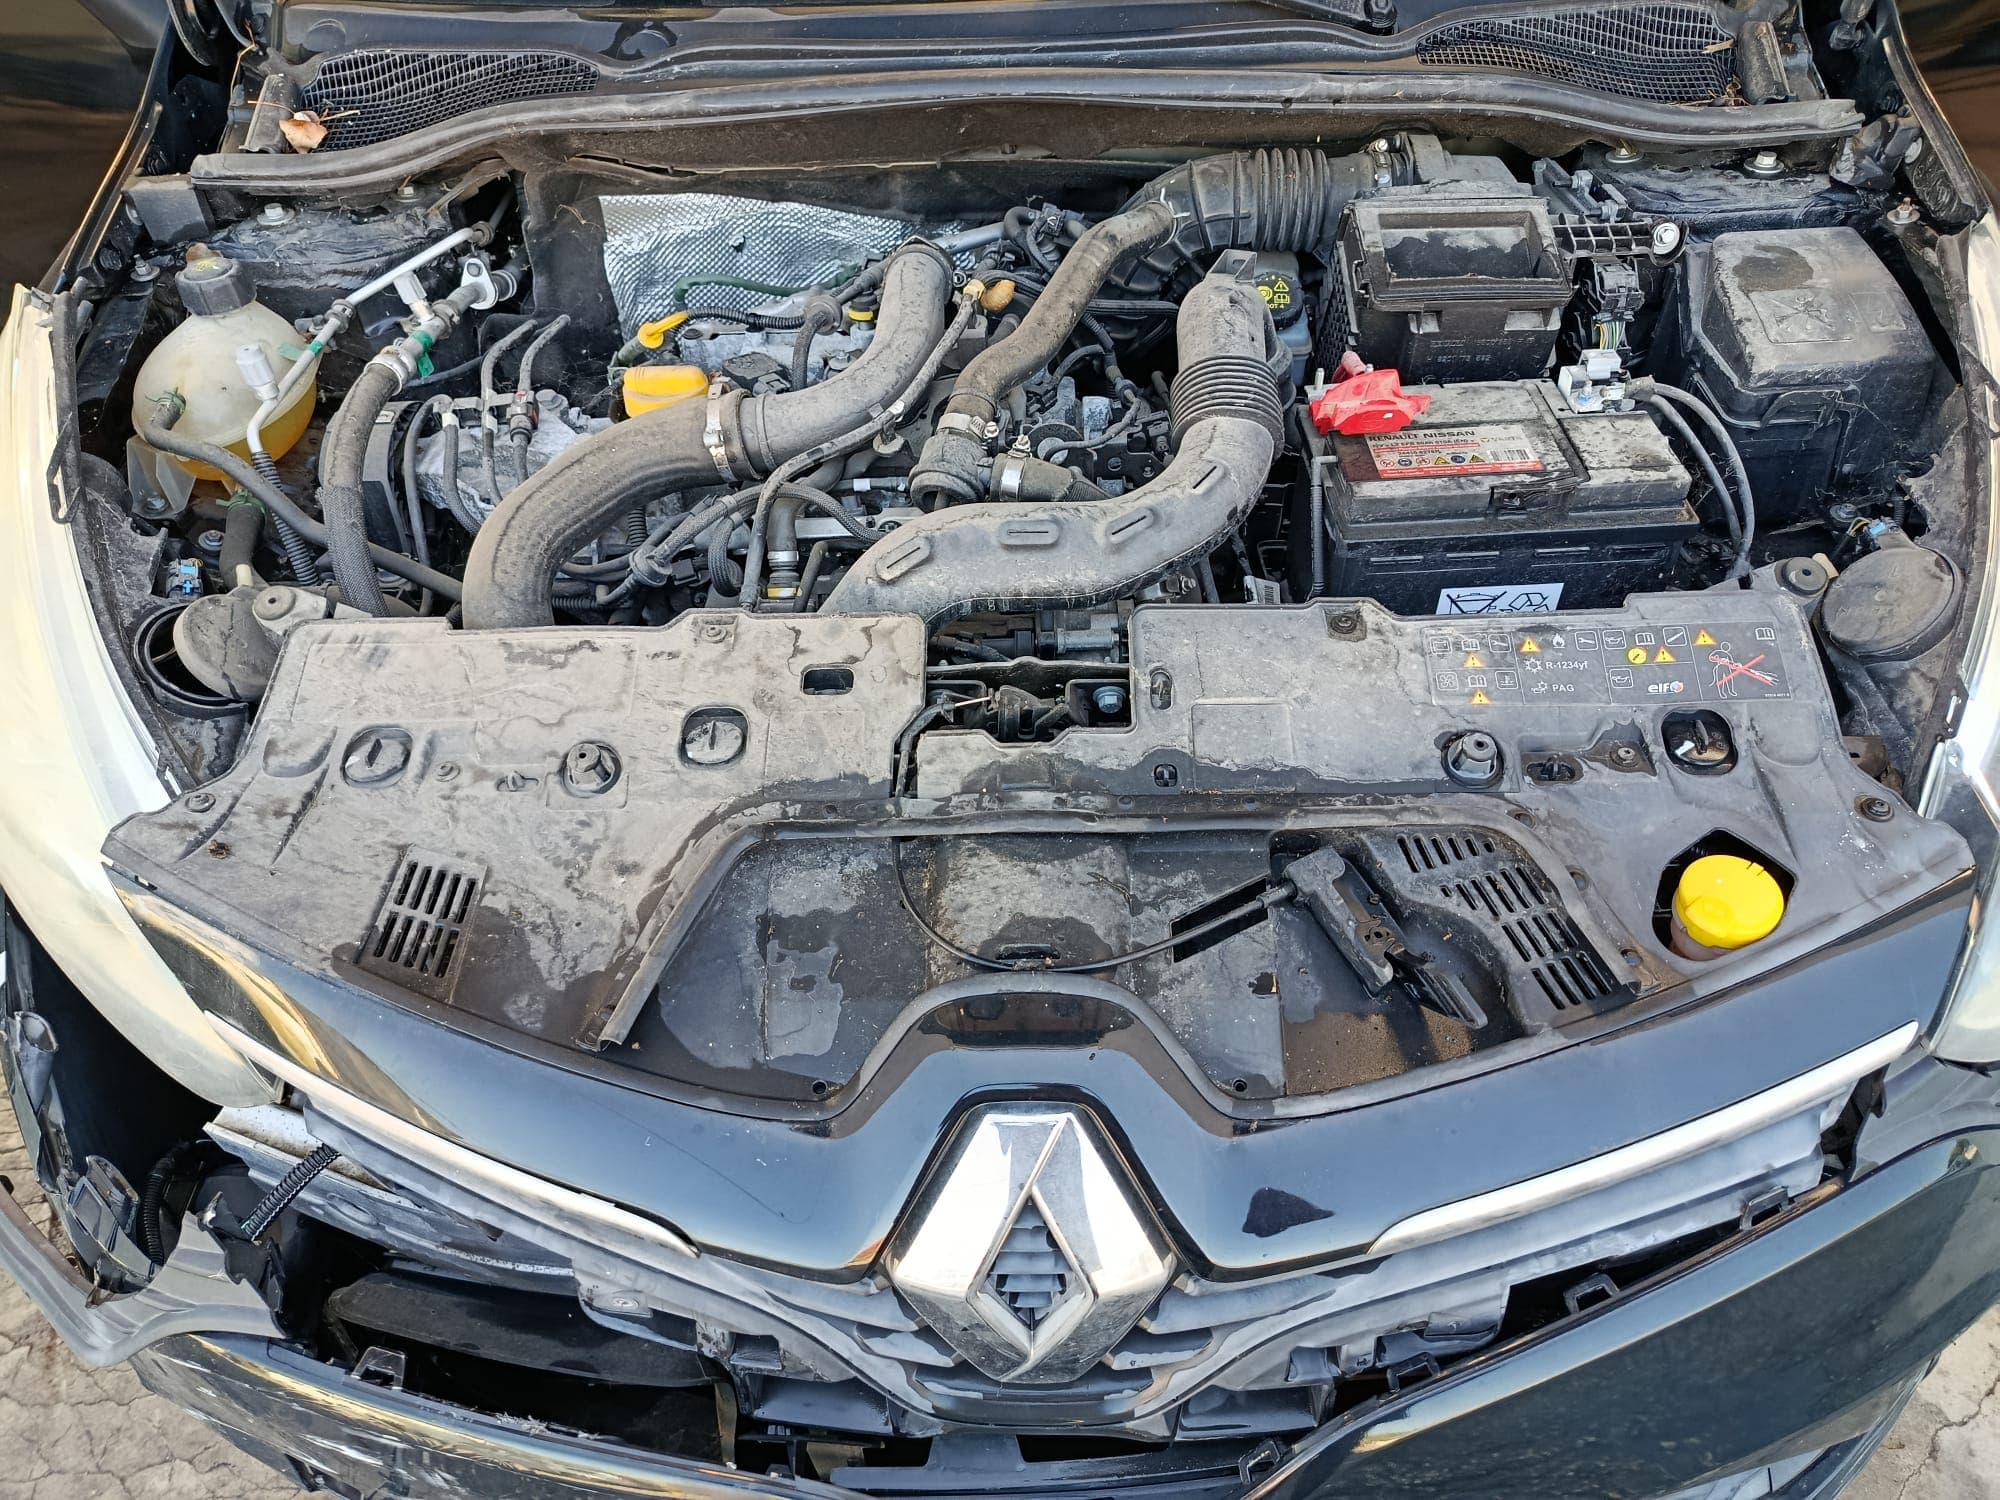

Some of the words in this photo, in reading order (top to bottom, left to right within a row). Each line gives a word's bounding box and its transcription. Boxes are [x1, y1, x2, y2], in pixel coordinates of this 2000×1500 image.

[1369, 433, 1419, 442] RENAULT
[1423, 430, 1476, 438] NISSAN
[1545, 660, 1589, 671] R-1234yf
[1552, 683, 1575, 692] PAG
[1647, 682, 1672, 693] elf
